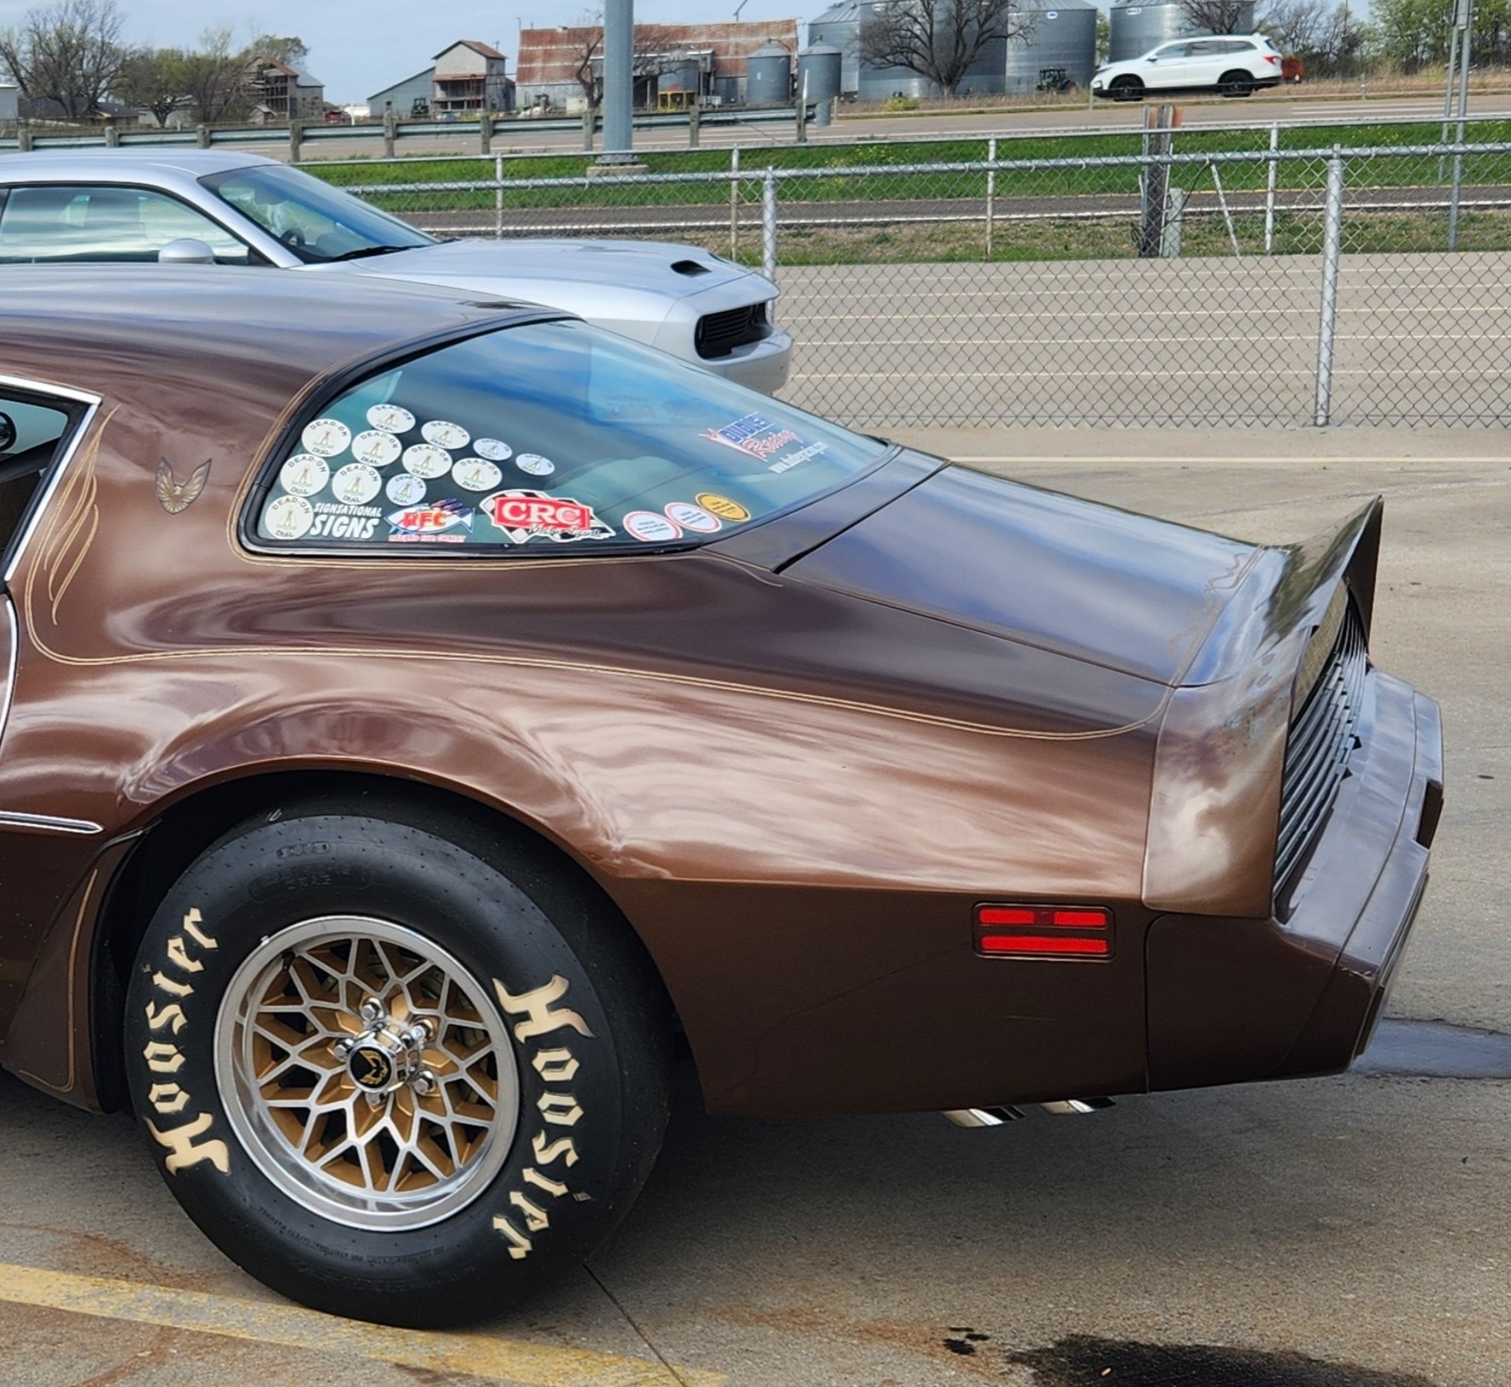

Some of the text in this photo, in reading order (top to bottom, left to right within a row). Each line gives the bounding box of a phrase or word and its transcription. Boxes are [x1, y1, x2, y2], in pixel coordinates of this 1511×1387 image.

[313, 502, 382, 517] SIGNSATIONAL
[502, 501, 581, 525] CRC
[310, 515, 380, 539] SIGNS
[142, 907, 232, 1177] Hoosier
[492, 973, 597, 1260] Hoosier
